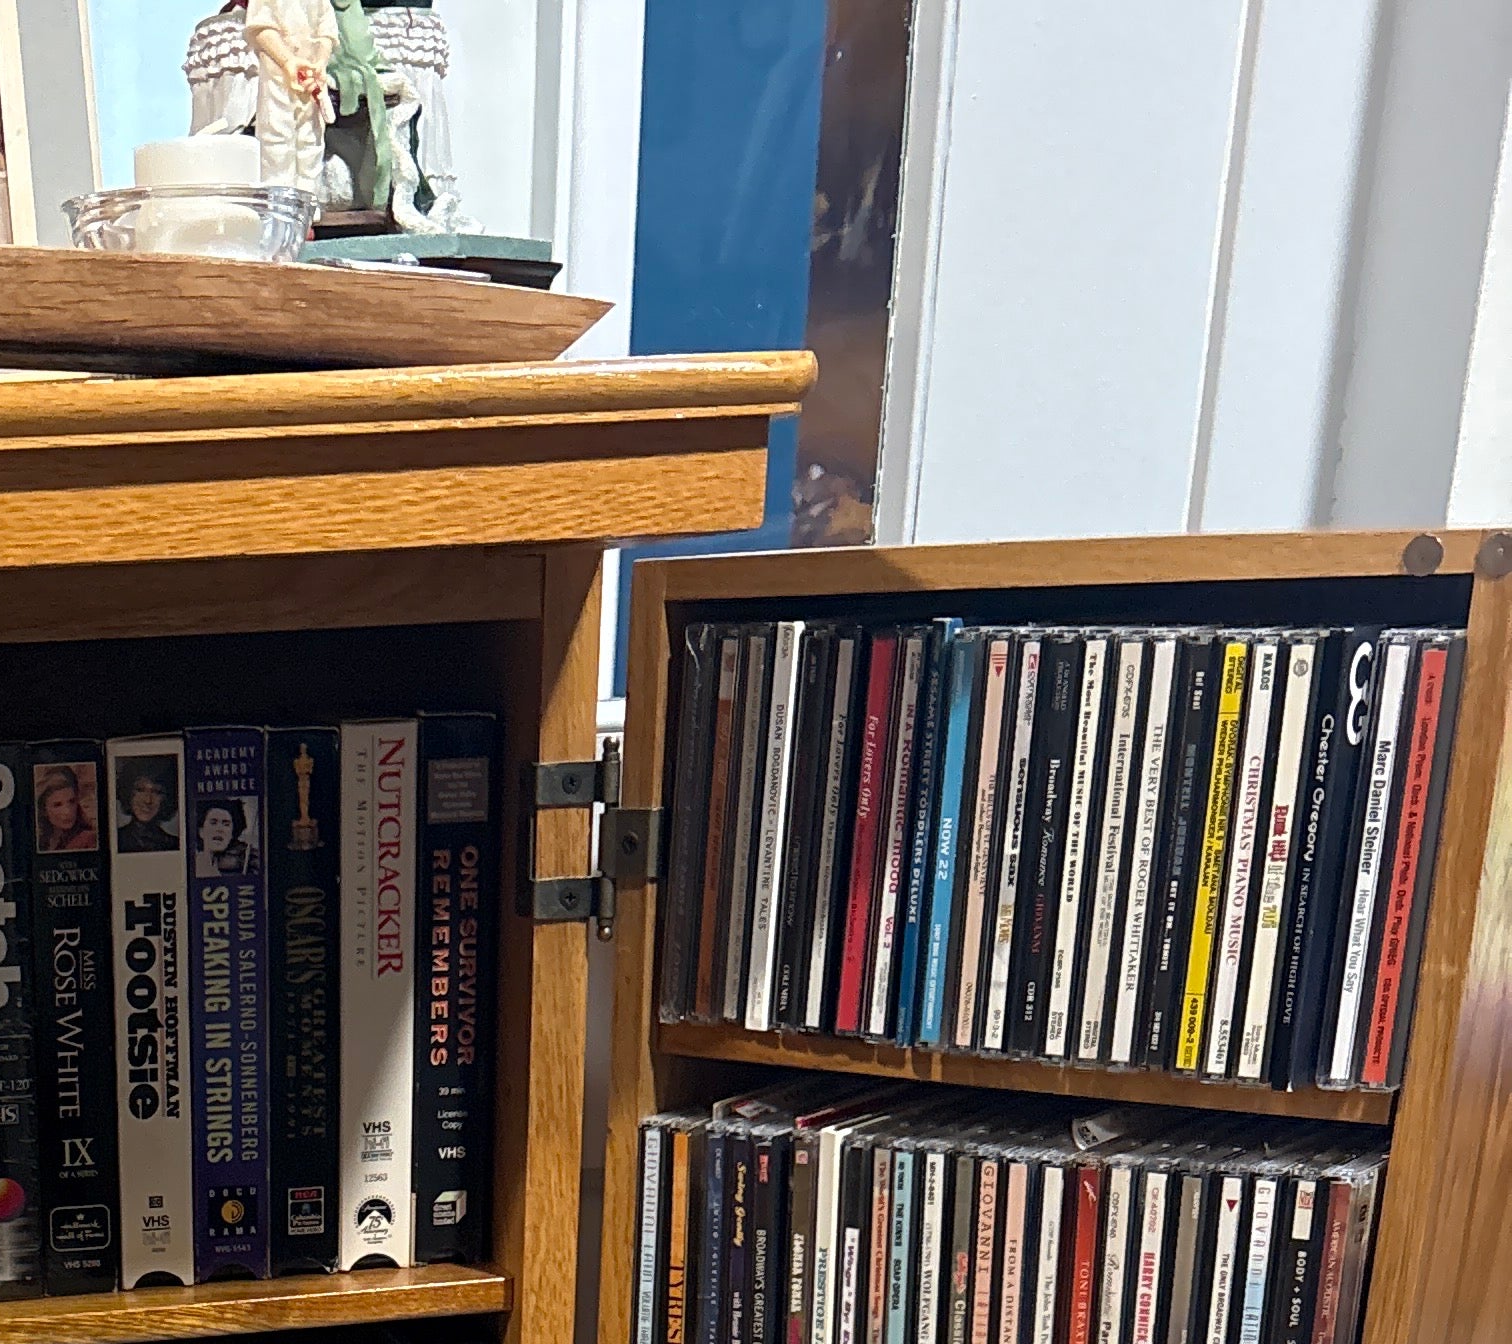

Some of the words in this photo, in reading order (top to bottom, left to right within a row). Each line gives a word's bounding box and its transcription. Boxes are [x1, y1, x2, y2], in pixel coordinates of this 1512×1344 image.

[1260, 654, 1273, 691] NAXOS
[866, 715, 879, 735] For
[1150, 725, 1164, 752] THE
[197, 747, 256, 760] ACADEMY
[204, 764, 247, 776] AWARD
[861, 739, 877, 784] Lovers
[1313, 714, 1335, 783] Chester
[1375, 741, 1391, 776] Marc
[198, 778, 256, 792] NOMINEE
[1109, 733, 1130, 819] International
[1147, 757, 1162, 794] VERY
[857, 787, 872, 819] Only
[1143, 800, 1156, 833] BEST
[1240, 756, 1260, 850] CHRISTMAS
[1368, 780, 1386, 823] Daniel
[940, 817, 953, 854] NOW
[1141, 837, 1152, 854] OF
[1304, 788, 1325, 861] Gregory
[378, 737, 404, 977] NUTCRACKER
[938, 860, 949, 879] 22
[1105, 826, 1120, 873] Festival
[1361, 827, 1380, 875] Steiner
[458, 847, 480, 902] ONE
[1135, 860, 1150, 908] ROGER
[1234, 859, 1248, 909] PIANO
[237, 884, 253, 940] NADJA
[1295, 885, 1309, 932] SEARCH
[1358, 889, 1370, 916] Hear
[202, 886, 231, 1012] SPEAKING
[1125, 912, 1146, 992] WHITTAKER
[1227, 915, 1244, 966] MUSIC
[1354, 920, 1368, 947] What
[53, 927, 78, 1006] ROSE
[80, 950, 95, 990] MISS
[430, 849, 451, 1067] REMEMBERS
[1288, 955, 1298, 988] HIGH
[1349, 950, 1363, 970] You
[458, 910, 480, 1066] SURVIVOR
[1344, 973, 1359, 992] Say
[125, 893, 160, 1120] Tootsie
[1283, 991, 1295, 1023] LOVE
[205, 1020, 230, 1048] IN
[239, 949, 259, 1162] SALERNO-SONNENBERG
[58, 1010, 84, 1118] WHITE
[204, 1055, 233, 1163] STRINGS
[364, 1121, 391, 1134] VHS
[61, 1139, 95, 1166] IX
[438, 1147, 466, 1159] VHS
[142, 1216, 170, 1228] VHS
[978, 1166, 993, 1273] GIOVANNI
[754, 1230, 767, 1289] BROADWAY'S
[1006, 1239, 1018, 1275] FROM
[1294, 1251, 1307, 1282] BODY
[815, 1248, 827, 1329] PRESTIGE
[920, 1270, 932, 1339] WOLFGANG
[752, 1293, 765, 1339] GREATEST
[1289, 1298, 1302, 1327] SOUL
